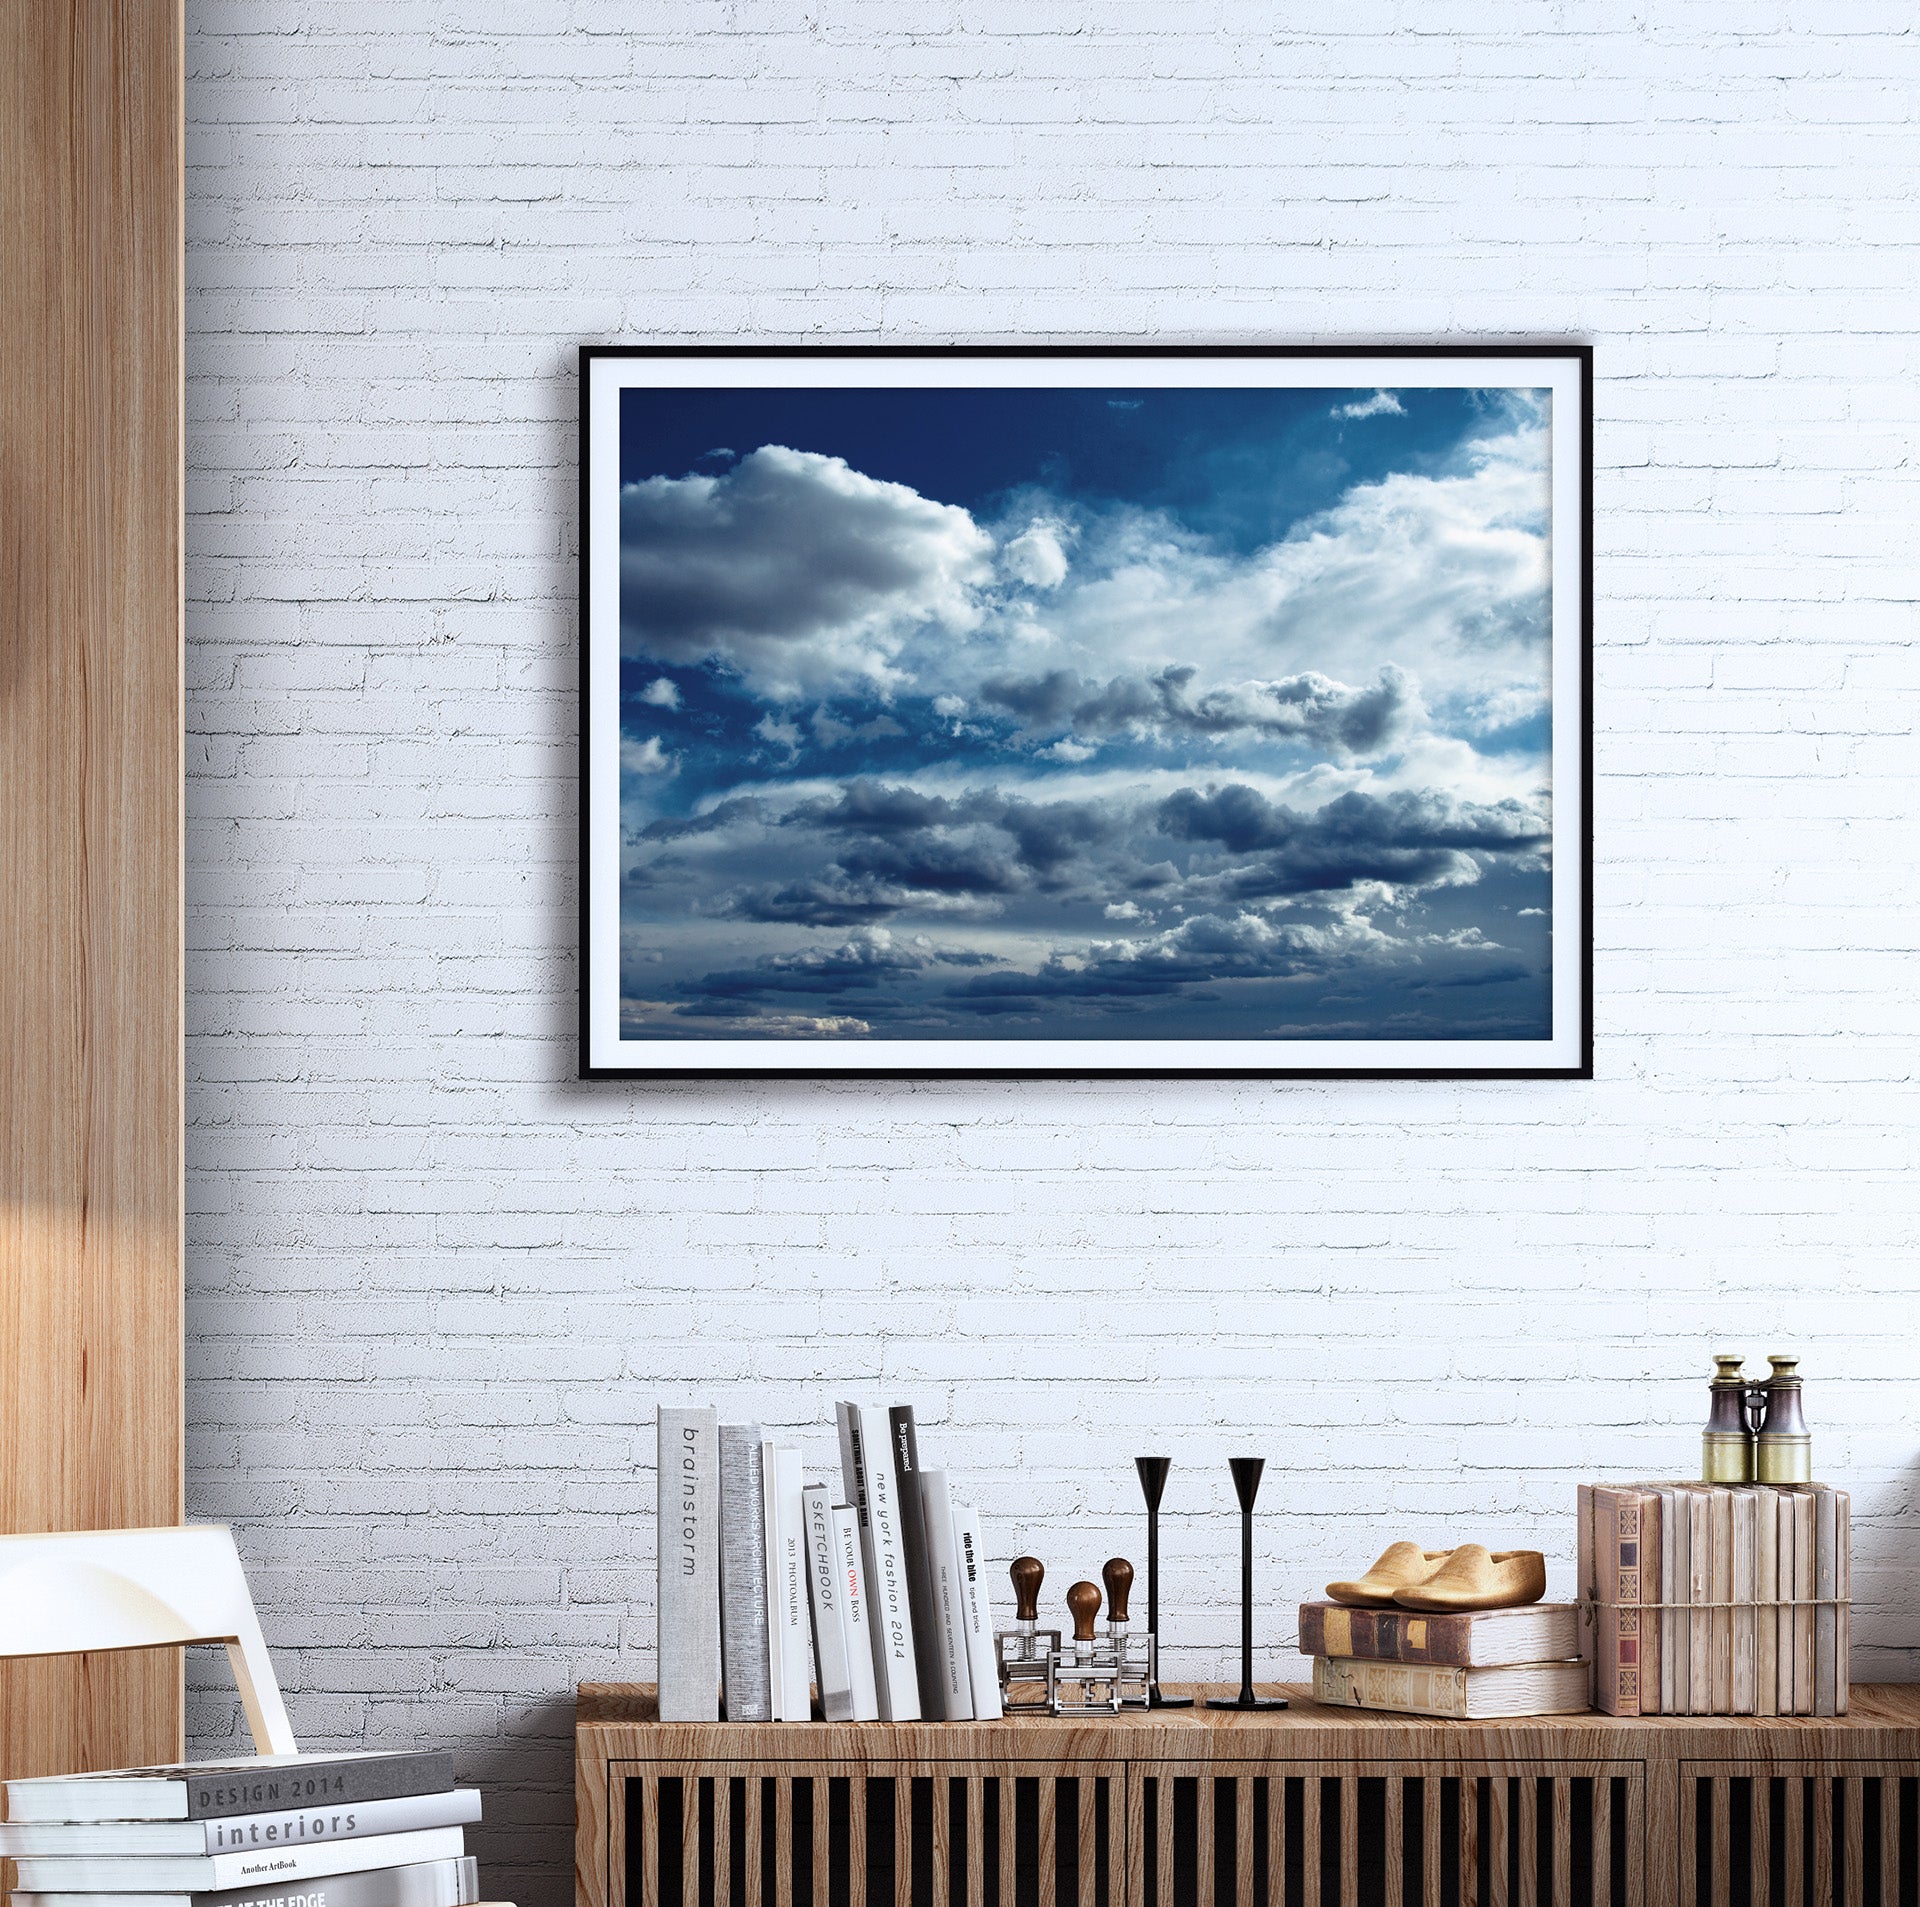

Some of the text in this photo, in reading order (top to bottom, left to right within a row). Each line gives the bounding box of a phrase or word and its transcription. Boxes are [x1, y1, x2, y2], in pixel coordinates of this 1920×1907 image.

[899, 1423, 912, 1472] Be prepared
[852, 1429, 869, 1527] SOMETHING ABOUT YOUR BRAIN
[683, 1427, 699, 1576] brainstorm
[749, 1443, 765, 1625] ALLIED WORKS ARCHITECTURE
[963, 1532, 972, 1549] ride
[812, 1501, 834, 1611] SKETCHBOOK
[876, 1473, 905, 1658] new york fashion 2014
[965, 1550, 974, 1563] the
[788, 1538, 798, 1626] 2013 PHOTOALBUM
[843, 1528, 860, 1623] BE YOUR OWN BOSS
[967, 1564, 976, 1582] bike
[942, 1585, 950, 1611] HUNDRED
[947, 1628, 955, 1659] SEVENTEEN
[950, 1666, 959, 1694] COUNTING
[200, 1776, 344, 1807] DESIGN 2014
[217, 1814, 356, 1846] interiors
[241, 1860, 297, 1875] Another ArtBook
[288, 1892, 326, 1907] EDGE
